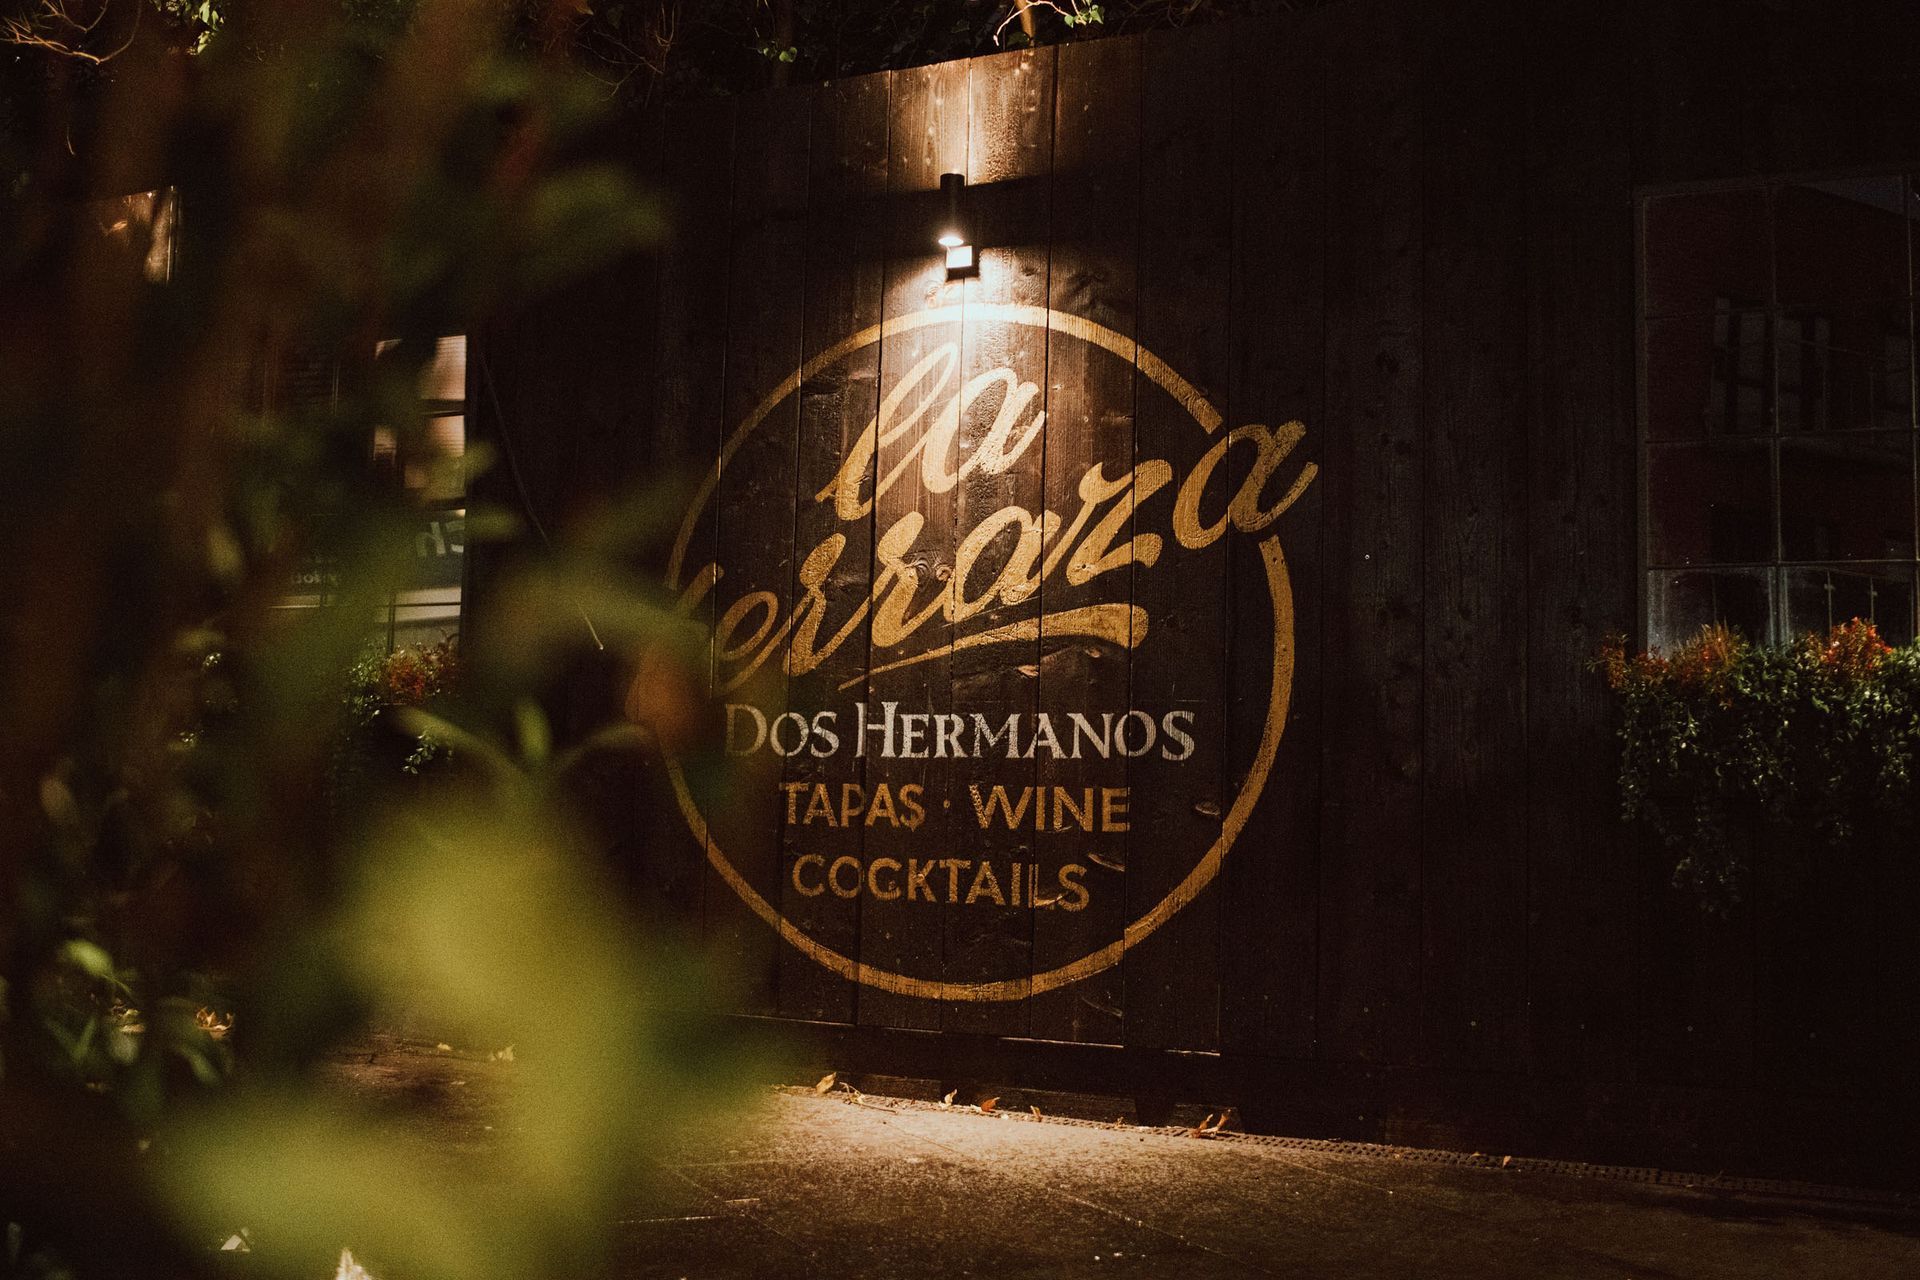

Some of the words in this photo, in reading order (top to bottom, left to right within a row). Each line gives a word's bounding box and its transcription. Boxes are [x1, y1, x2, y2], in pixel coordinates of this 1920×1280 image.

[814, 342, 1048, 521] la
[724, 702, 840, 759] DOS
[854, 700, 1196, 762] HERMANOS
[779, 782, 926, 832] TAPAS
[968, 784, 1131, 832] WINE
[792, 853, 1090, 912] COCKTAILS
